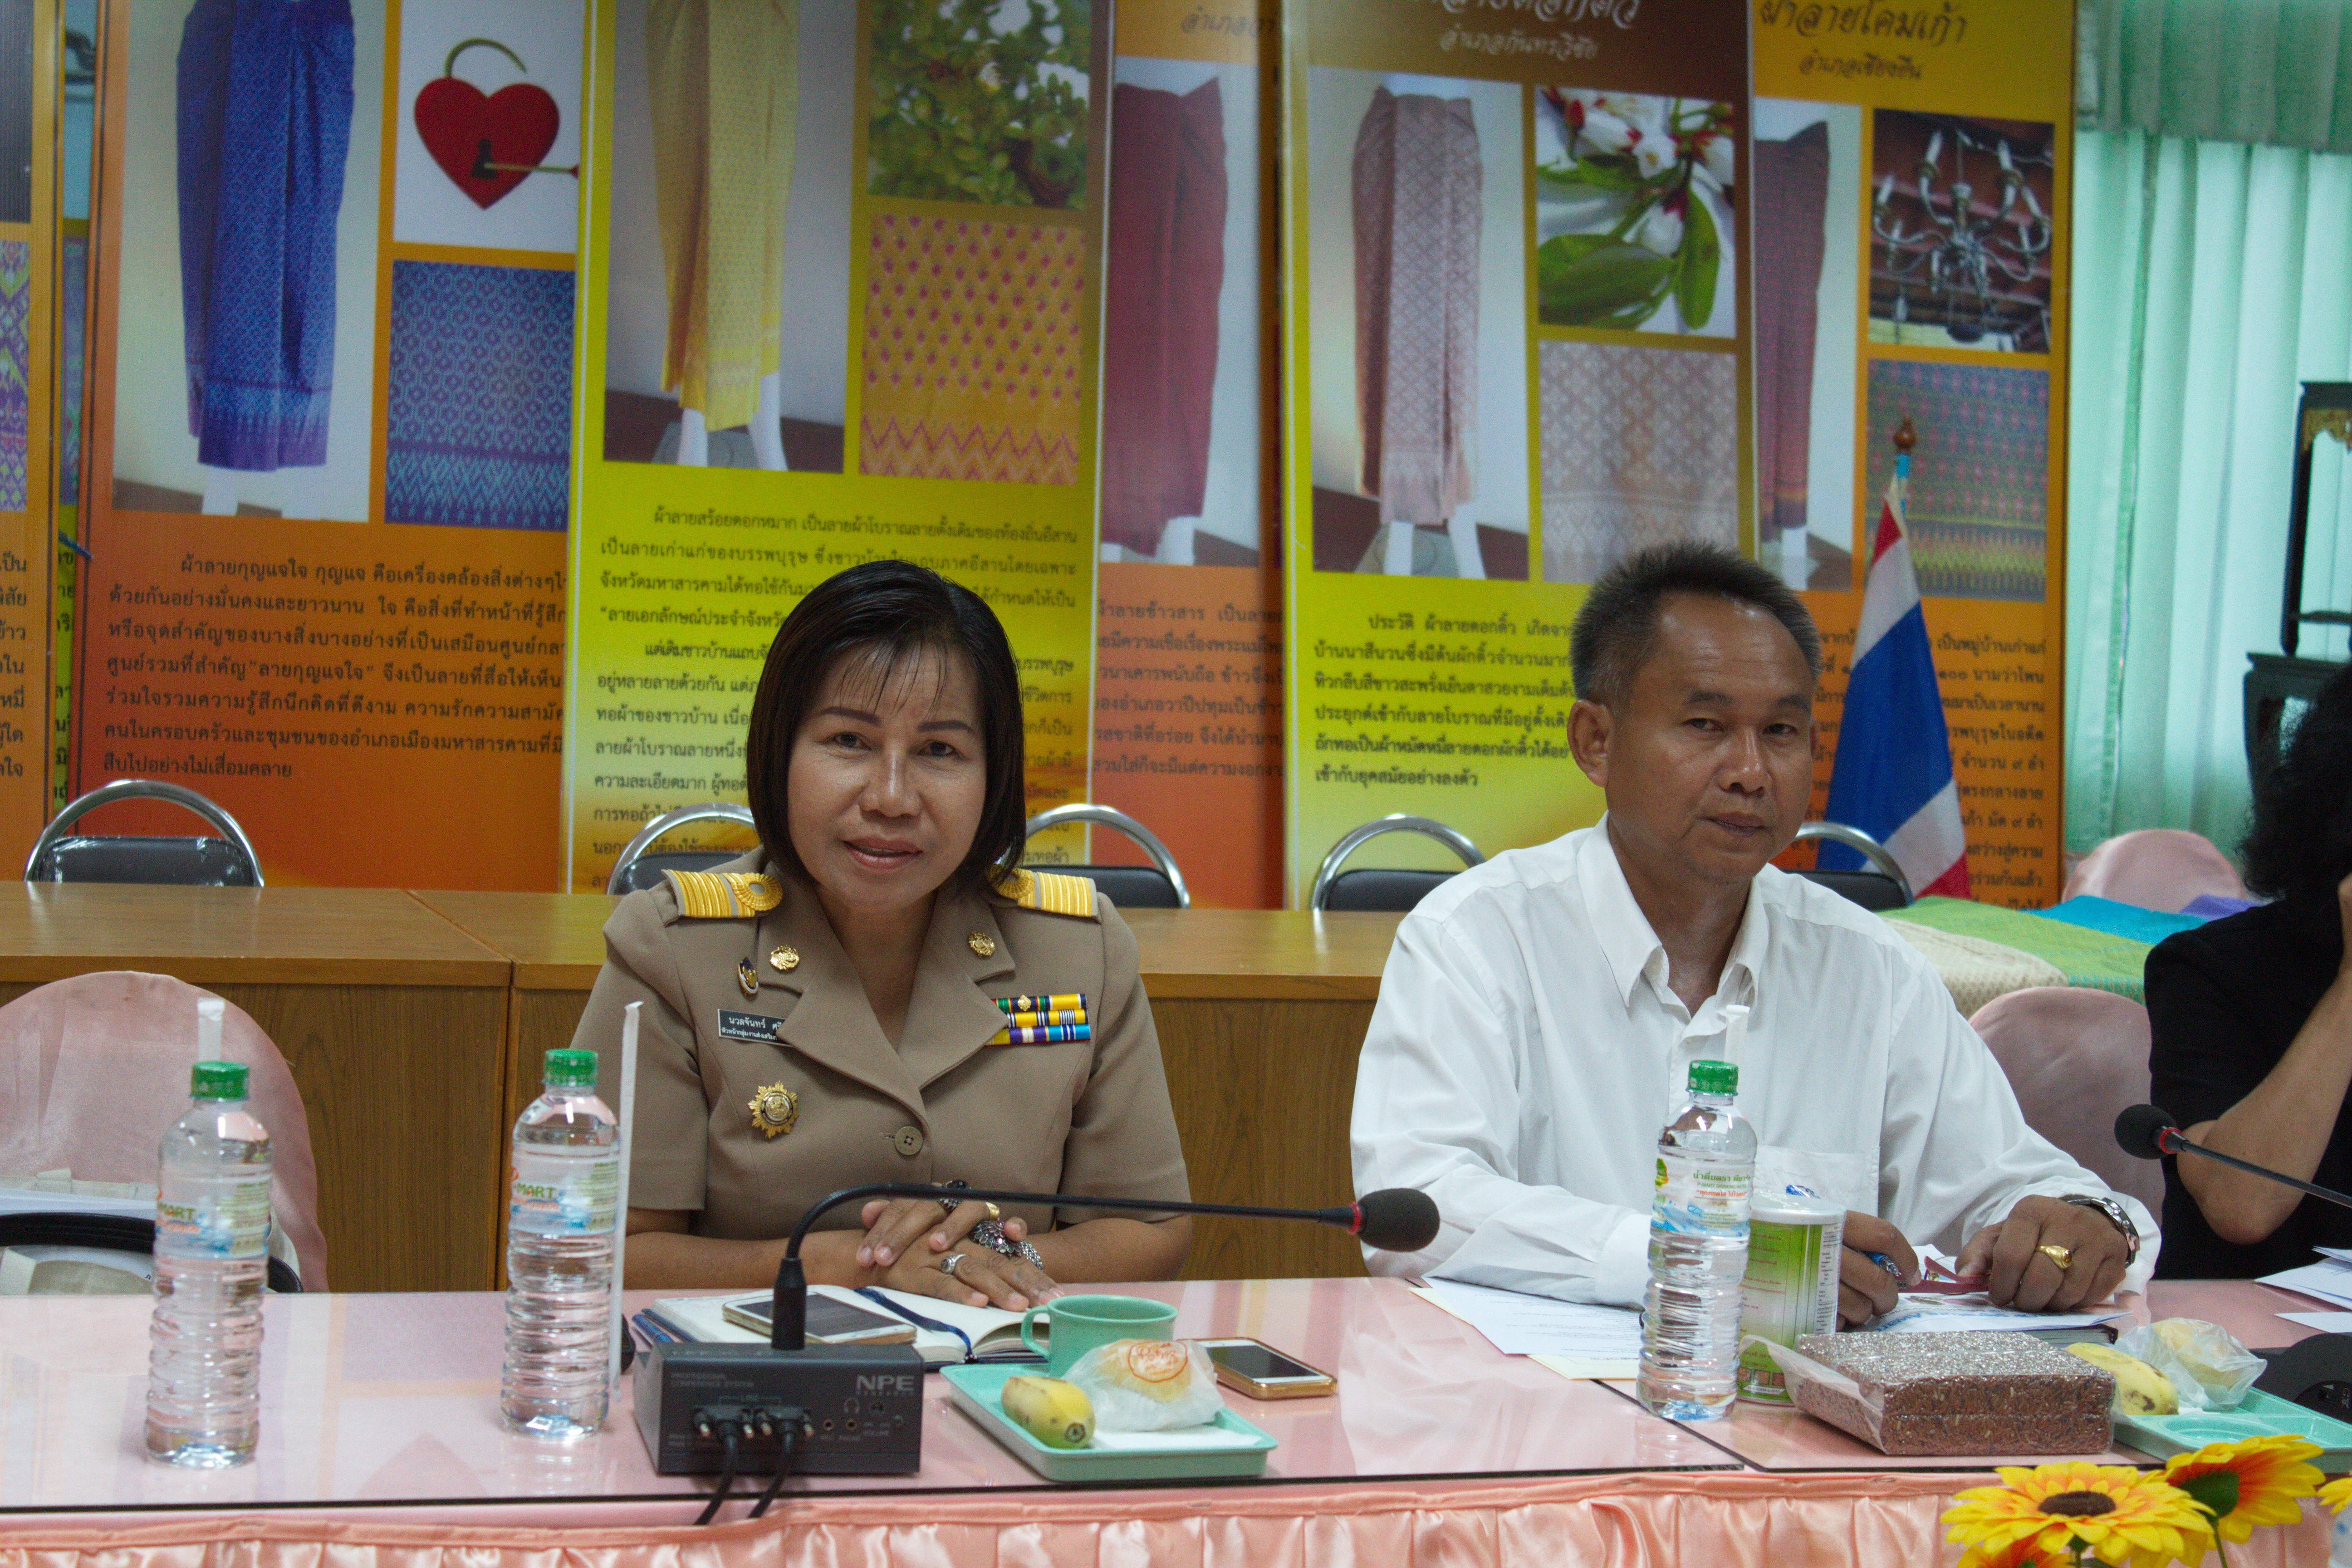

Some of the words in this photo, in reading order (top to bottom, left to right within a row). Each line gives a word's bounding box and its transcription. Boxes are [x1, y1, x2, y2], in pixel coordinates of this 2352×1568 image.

[654, 504, 797, 530] ผ้าลายสร้อยดอกหมาก
[601, 535, 808, 568] เป็นลายเก่าแก่ของบรรพบุรุษ
[181, 552, 308, 582] ผ้าลายกุญแจใจ
[315, 565, 366, 586] กุญแจ
[373, 560, 566, 593] คือเครื่องคล้องสิ่งต่างๆไ
[109, 583, 364, 615] ด้วยกันอย่างมั่นคงและยาวนาน
[377, 595, 397, 616] ใจ
[1368, 611, 1415, 631] ประวัติ
[597, 670, 726, 694] อยู่หลายลายด้วยกัน
[106, 685, 397, 716] ร่วมใจรวมความรู้สึกนึกคิดที่ดีงาม
[596, 701, 718, 725] ทอผ้าของชาวบ้าน
[103, 751, 292, 778] สืบไปอย่างไม่เสื่อมคลาย
[1315, 762, 1479, 789] เข้ากับยุคสมัยอย่างลงตัว
[594, 771, 707, 791] ความละเอียดมาก
[729, 1017, 766, 1029] นวลจันทร์
[1693, 1170, 1731, 1182] น้ำดื่มตรา
[856, 1374, 916, 1390] NPE
